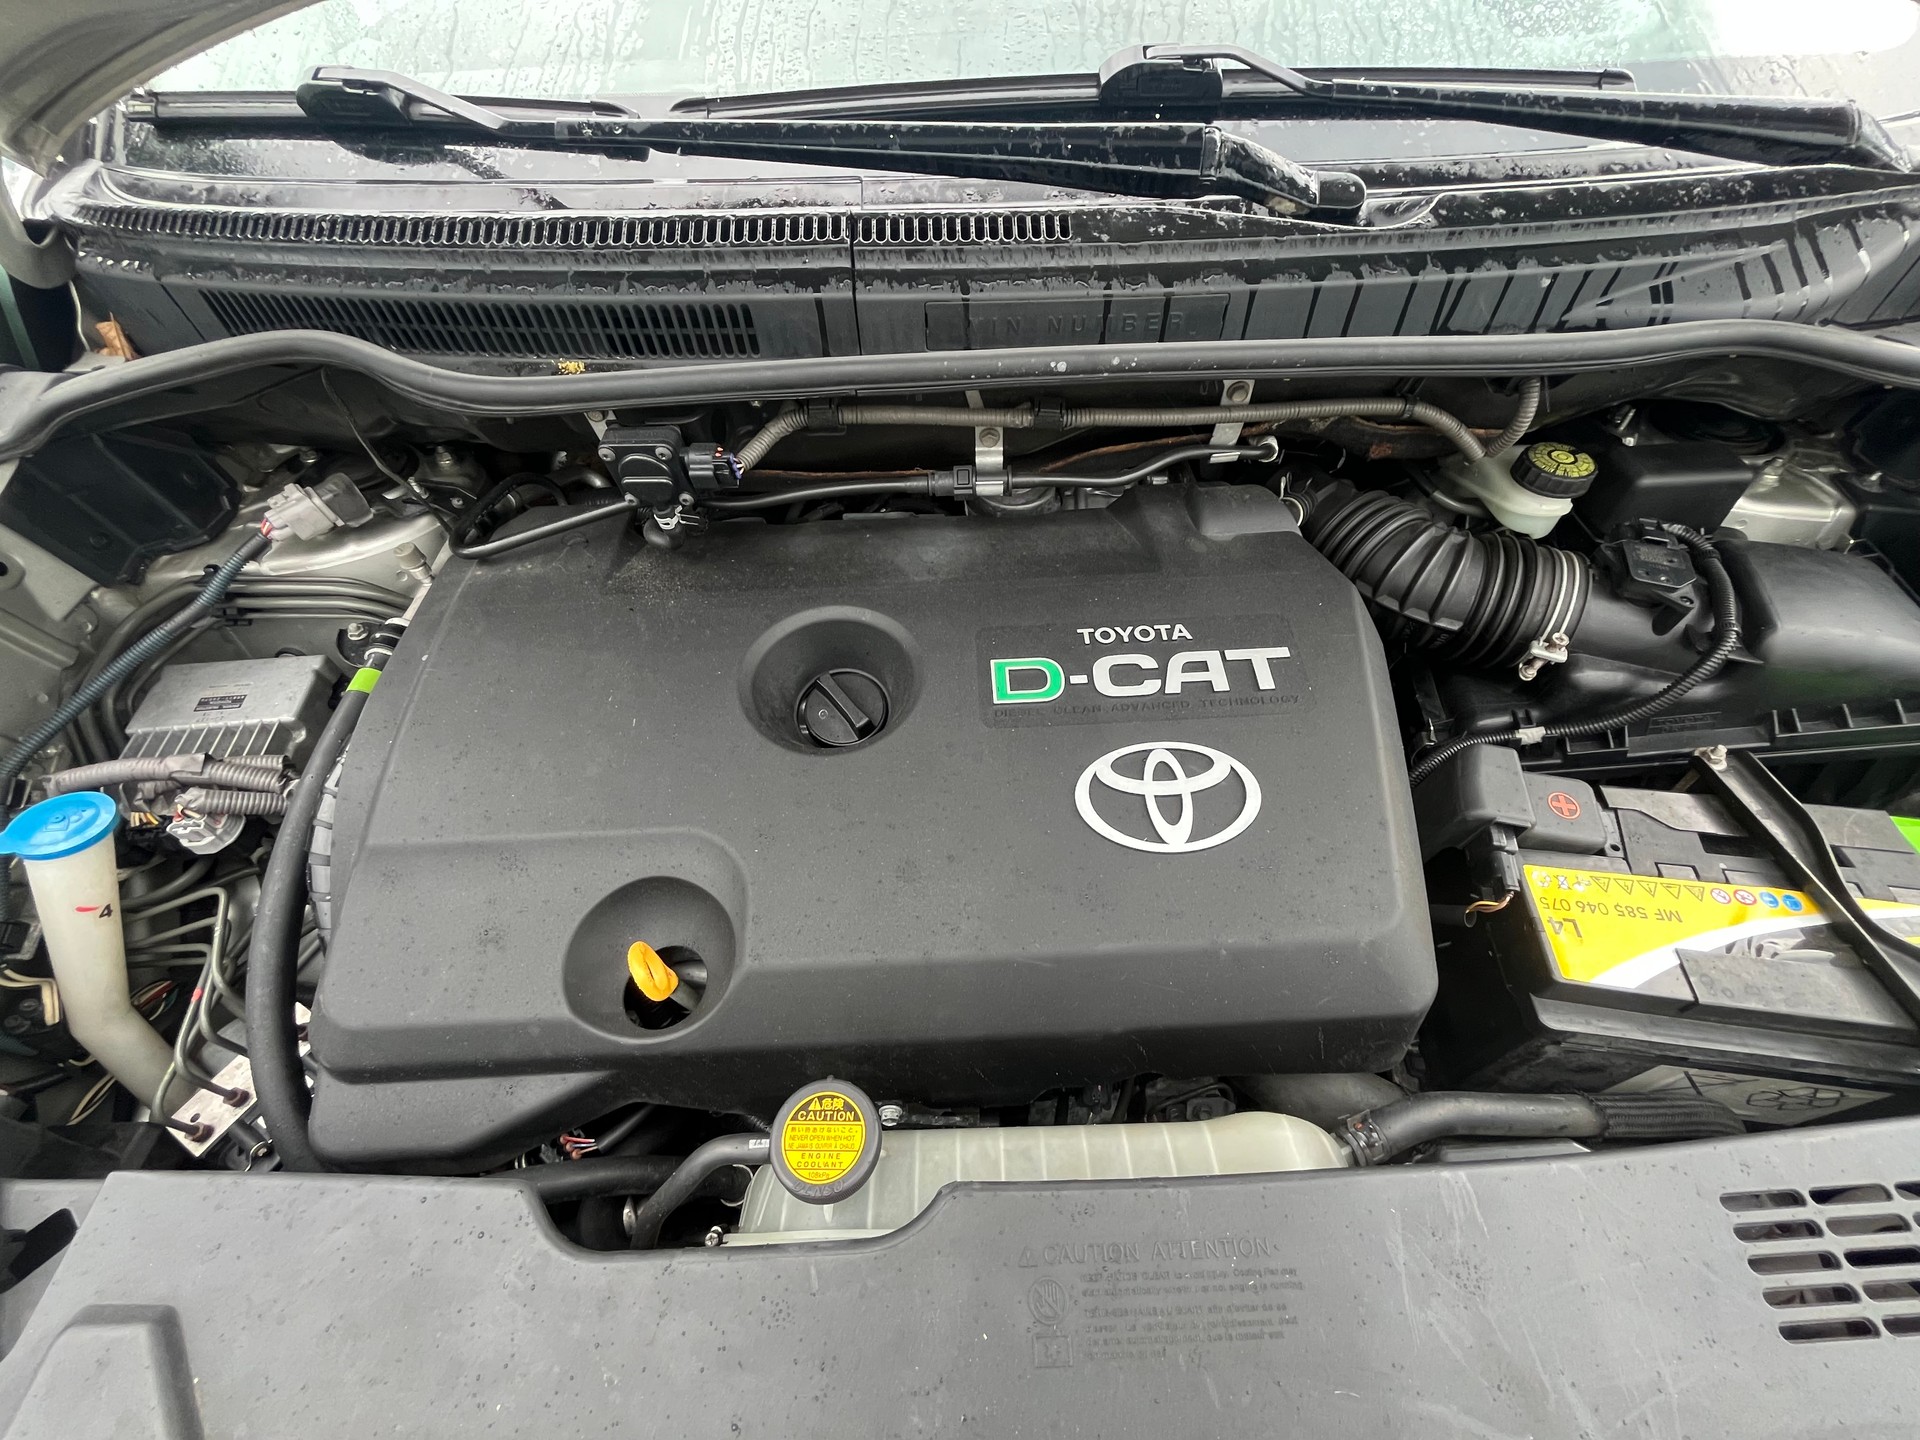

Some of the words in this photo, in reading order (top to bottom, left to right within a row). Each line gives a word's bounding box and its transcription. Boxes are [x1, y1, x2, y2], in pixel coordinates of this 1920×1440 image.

[1077, 623, 1193, 645] TOYOTA
[990, 646, 1291, 705] D-CAT
[1200, 693, 1300, 709] TECHNOLOGY
[98, 903, 114, 919] 4
[1539, 896, 1571, 912] 075
[1575, 900, 1609, 916] 046
[1614, 903, 1649, 919] 585
[1654, 908, 1683, 923] MF
[1547, 916, 1583, 939] L4
[797, 1110, 855, 1121] CAUTION
[789, 1134, 809, 1142] NEVER
[809, 1134, 826, 1142] OPEN
[826, 1134, 843, 1142] WHEN
[800, 1152, 841, 1160] ENGINE
[1043, 1241, 1141, 1265] CAUTION
[1151, 1237, 1272, 1261] ATTENTION
